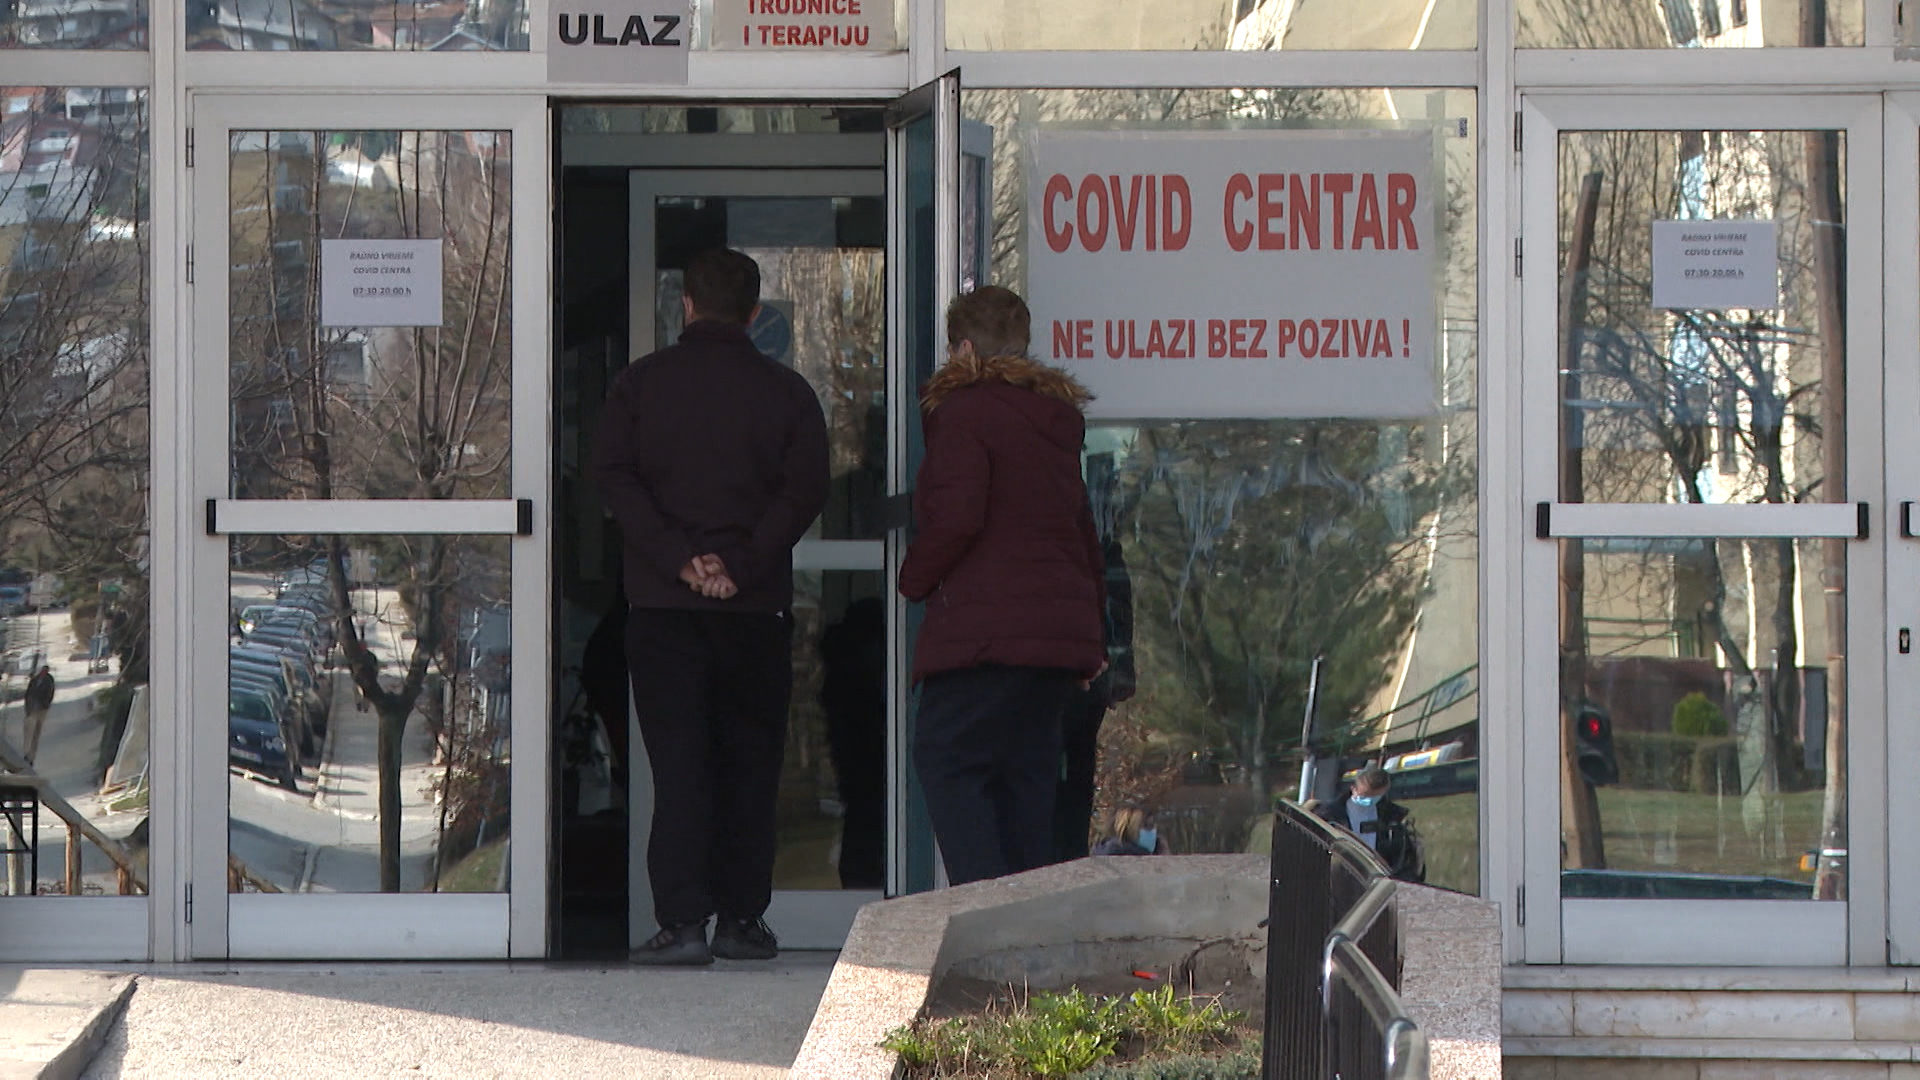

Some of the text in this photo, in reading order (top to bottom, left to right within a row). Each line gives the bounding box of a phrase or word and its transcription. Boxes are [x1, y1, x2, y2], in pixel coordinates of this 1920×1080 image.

[748, 0, 861, 15] TRUDNICE
[558, 13, 681, 46] ULAZ
[743, 25, 869, 46] I TERAPIJU
[1043, 172, 1419, 253] COVID CENTAR
[1712, 248, 1744, 256] CENTRA
[1052, 319, 1094, 359] NE
[1105, 319, 1196, 359] ULAZI
[1208, 319, 1267, 358] BEZ
[1278, 319, 1393, 358] POZIVA
